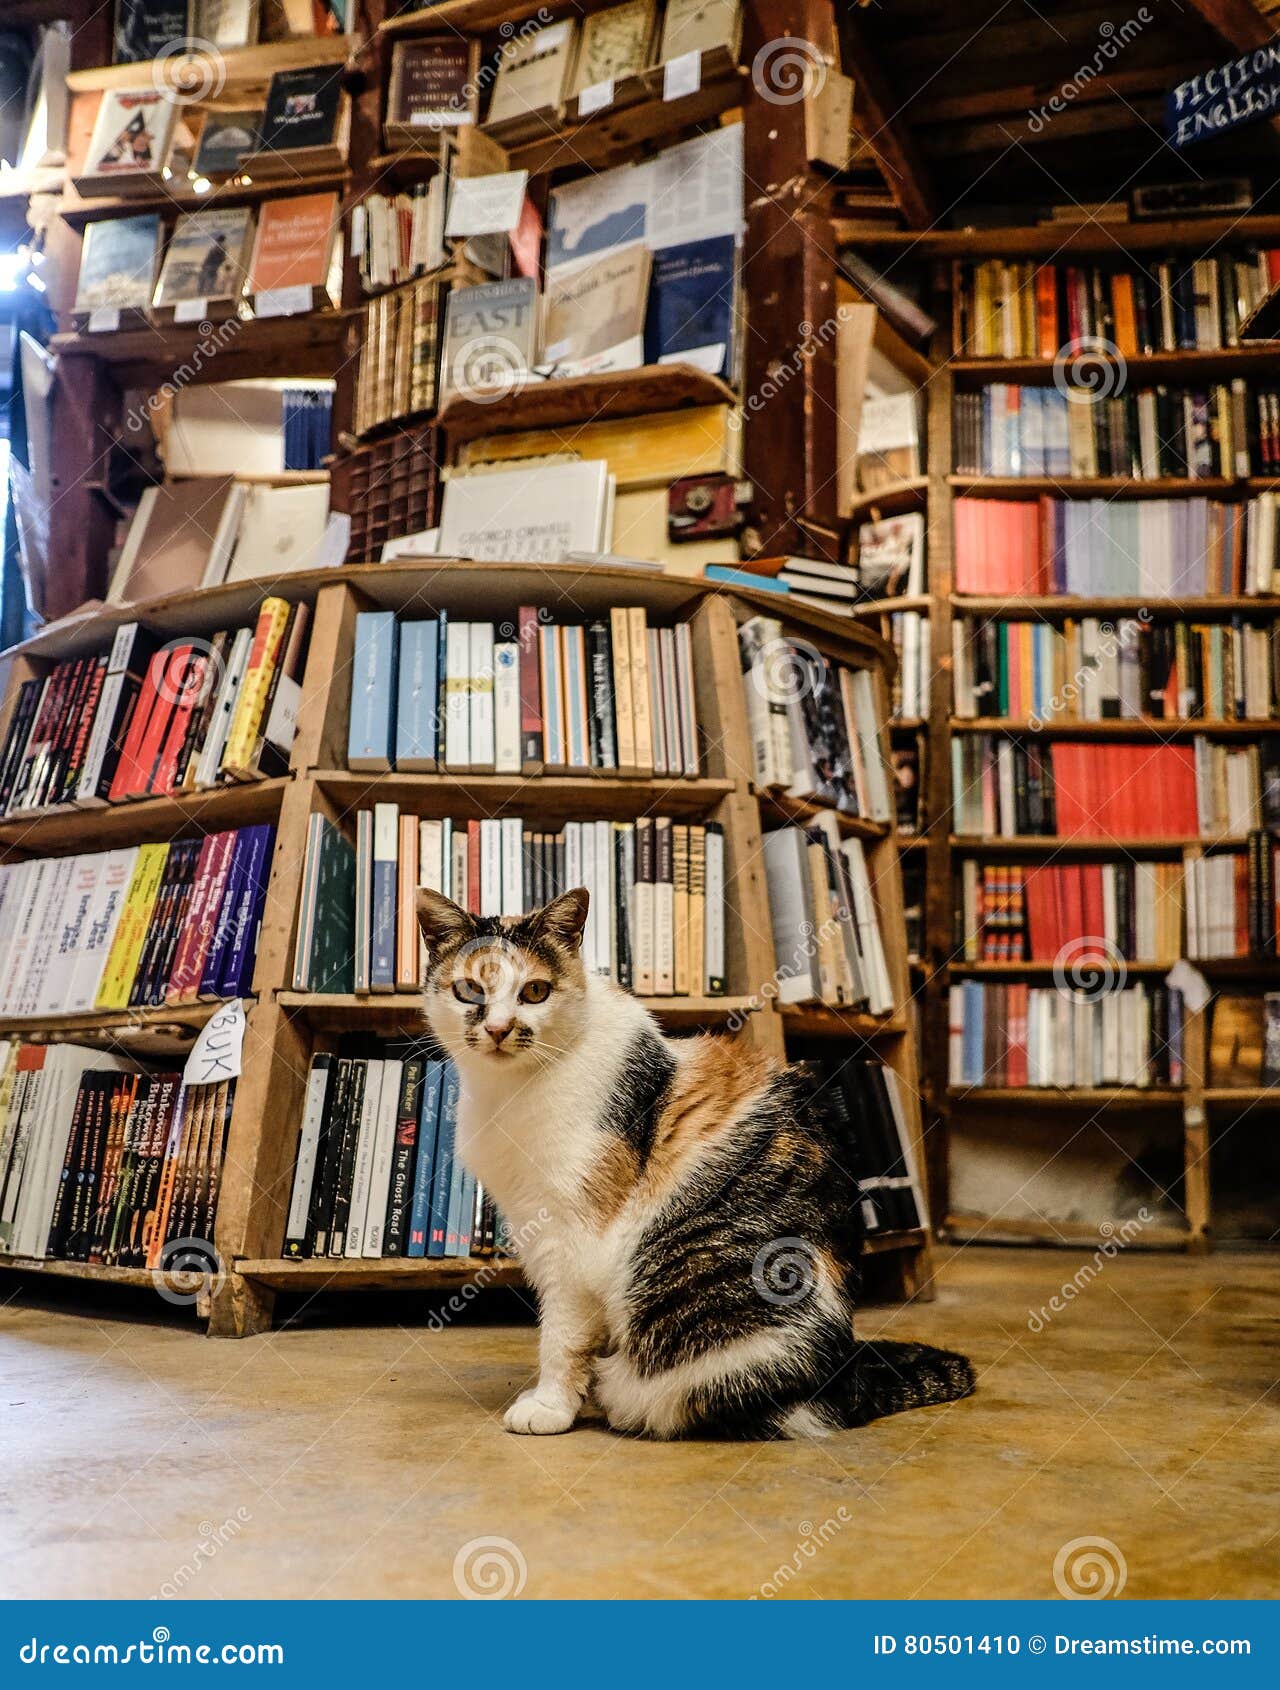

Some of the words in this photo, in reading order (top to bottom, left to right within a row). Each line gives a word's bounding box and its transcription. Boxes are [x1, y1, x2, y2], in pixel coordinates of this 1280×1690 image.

[450, 302, 531, 337] EAST
[69, 666, 105, 769] ENTRAPMENT
[68, 893, 91, 949] Infinite
[86, 919, 102, 951] Jest
[96, 889, 119, 945] Infinite
[58, 923, 74, 955] Jest
[201, 1014, 237, 1080] BUK
[407, 1065, 418, 1081] Pat
[403, 1082, 416, 1112] Barker
[138, 1082, 160, 1157] Bukowski
[151, 1081, 173, 1158] Bukowski
[163, 1140, 175, 1187] CHARLES
[397, 1149, 409, 1169] The
[129, 1159, 146, 1207] Women
[142, 1159, 159, 1208] Women
[393, 1172, 406, 1204] Ghost
[153, 1188, 167, 1243] BUKOWSKI
[389, 1207, 402, 1235] Road
[348, 1226, 359, 1250] PICADOR
[369, 1225, 379, 1249] PICADOR
